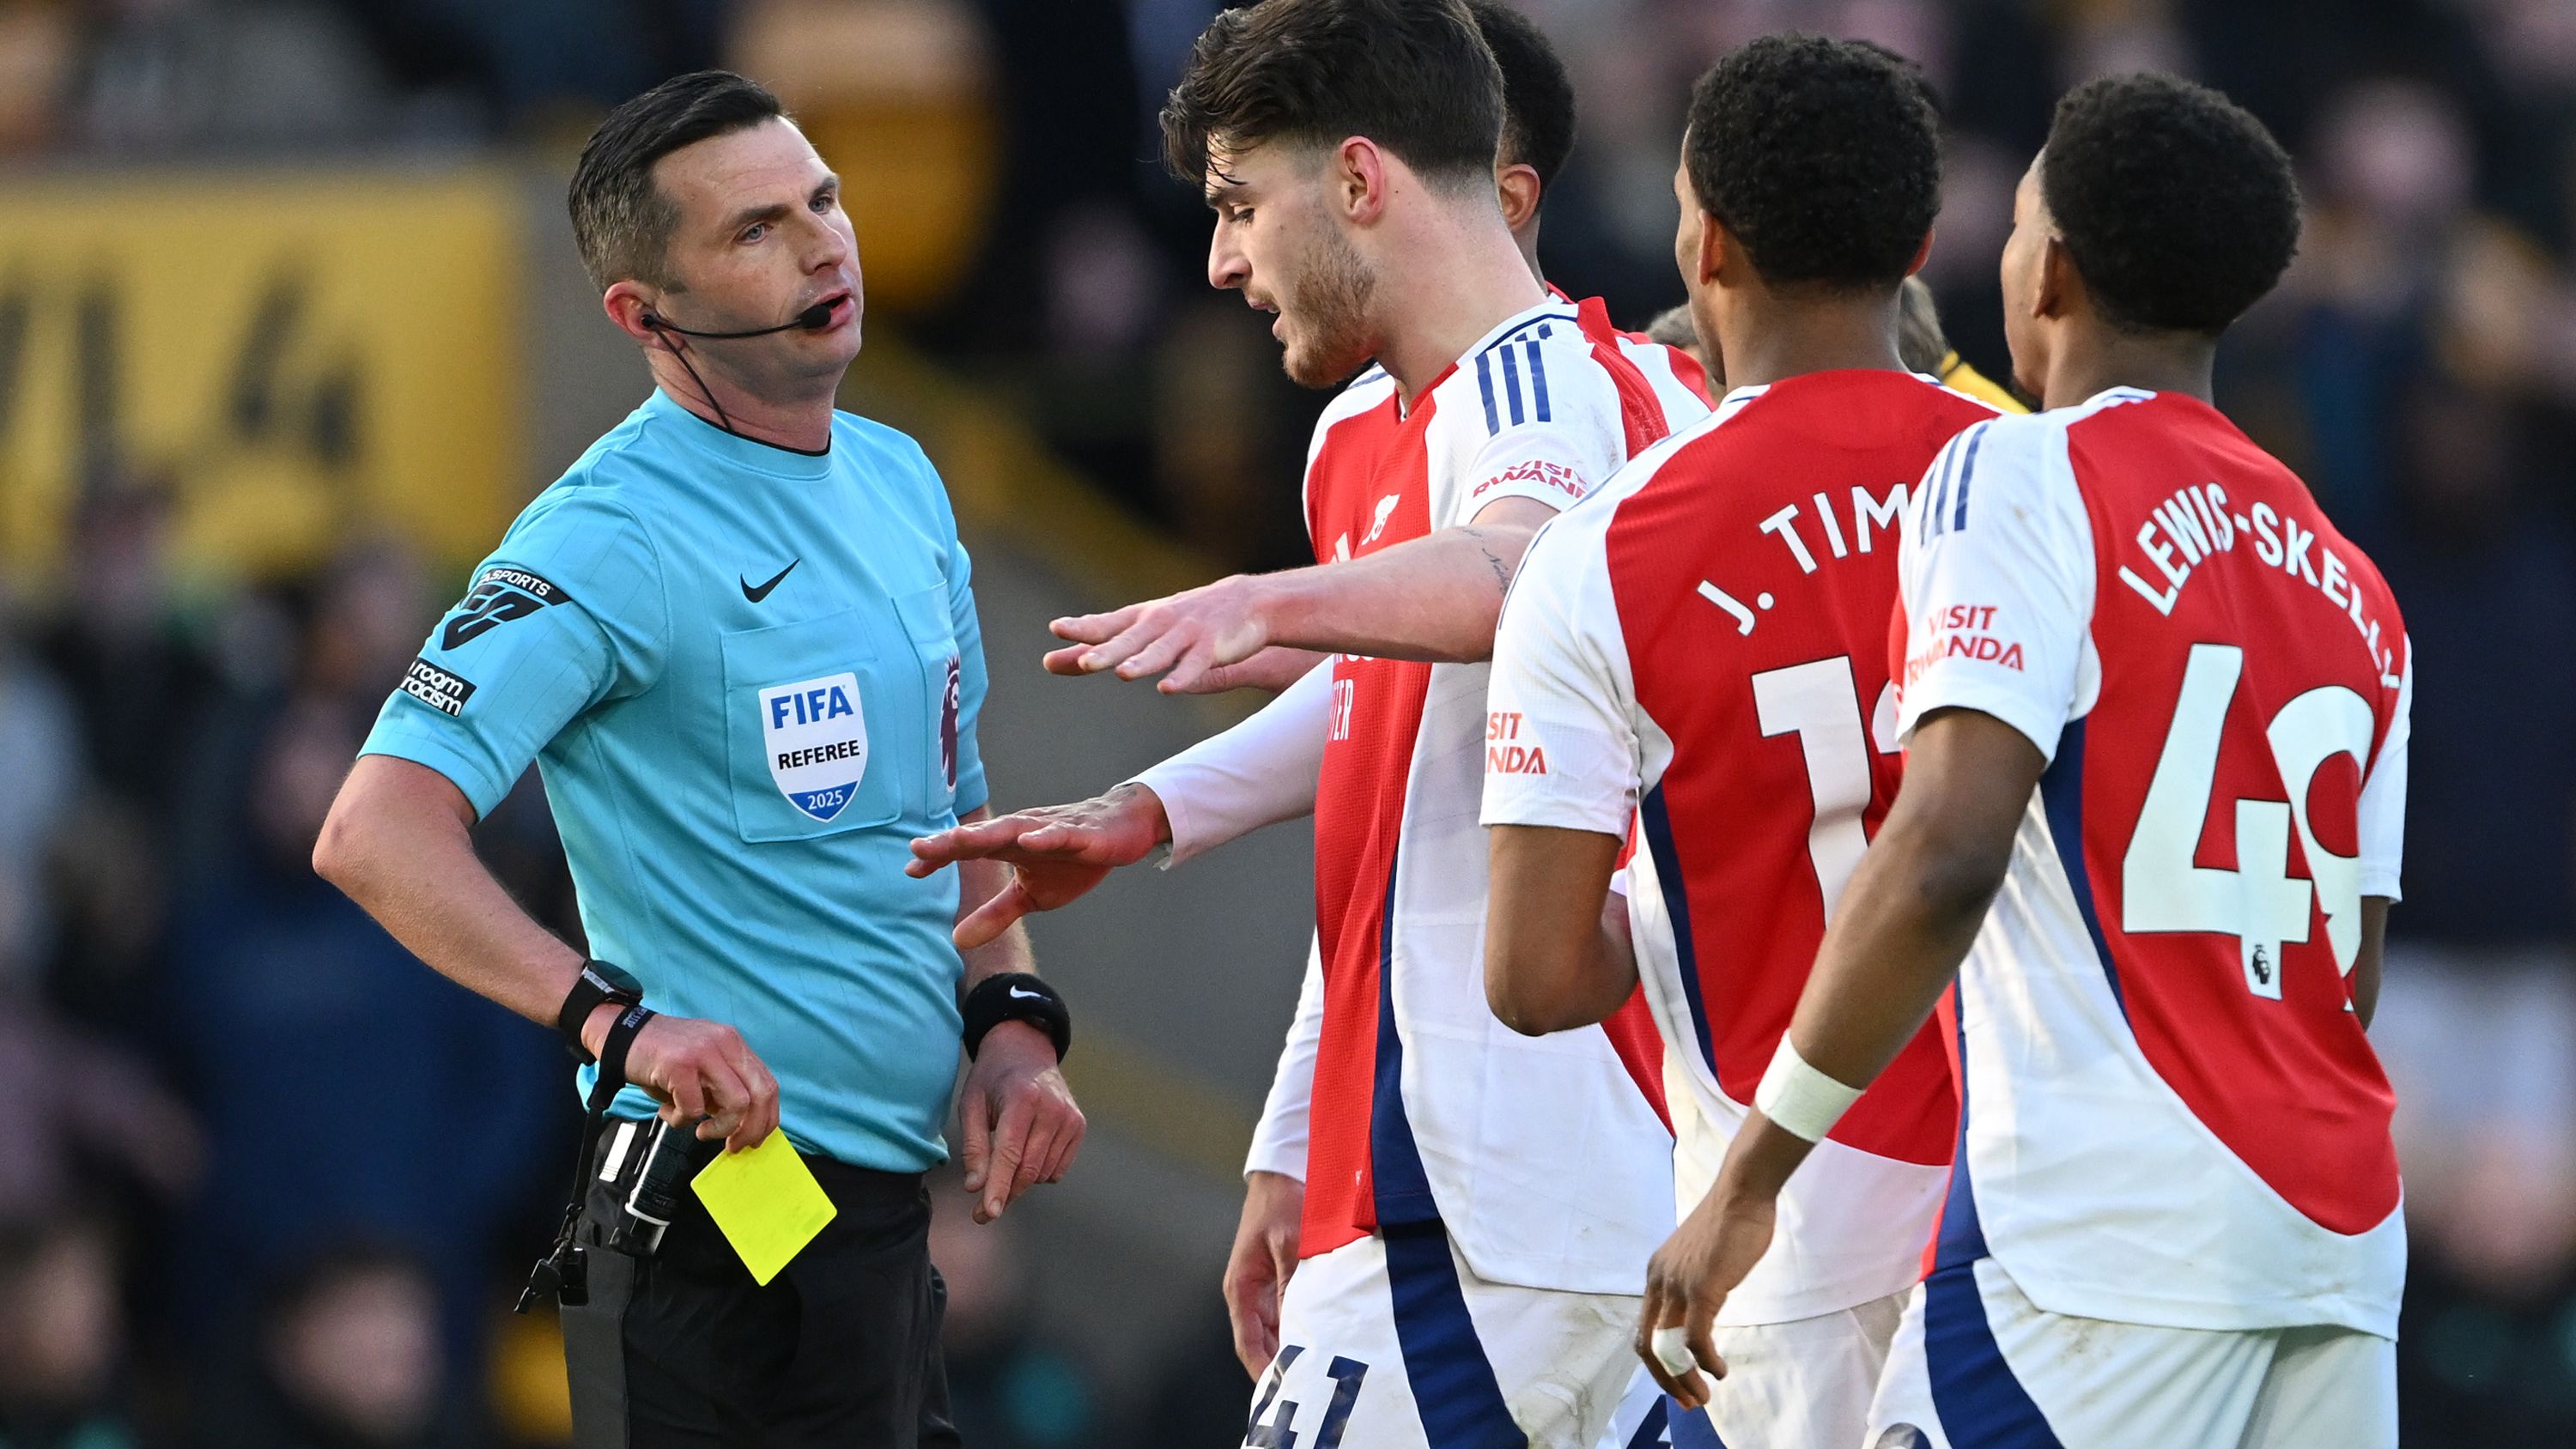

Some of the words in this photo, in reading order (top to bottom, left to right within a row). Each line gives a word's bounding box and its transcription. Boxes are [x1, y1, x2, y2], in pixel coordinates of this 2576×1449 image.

[2117, 482, 2402, 689] LEWIS-SKELLY
[1697, 579, 1775, 636] J.
[1929, 604, 1997, 637] VISIT
[400, 676, 462, 716] racism
[411, 663, 464, 697] room
[771, 685, 854, 730] FIFA
[778, 739, 860, 769] REFEREE
[807, 789, 843, 810] 2025
[2122, 642, 2376, 1001] 49
[1246, 1344, 1370, 1449] 41
